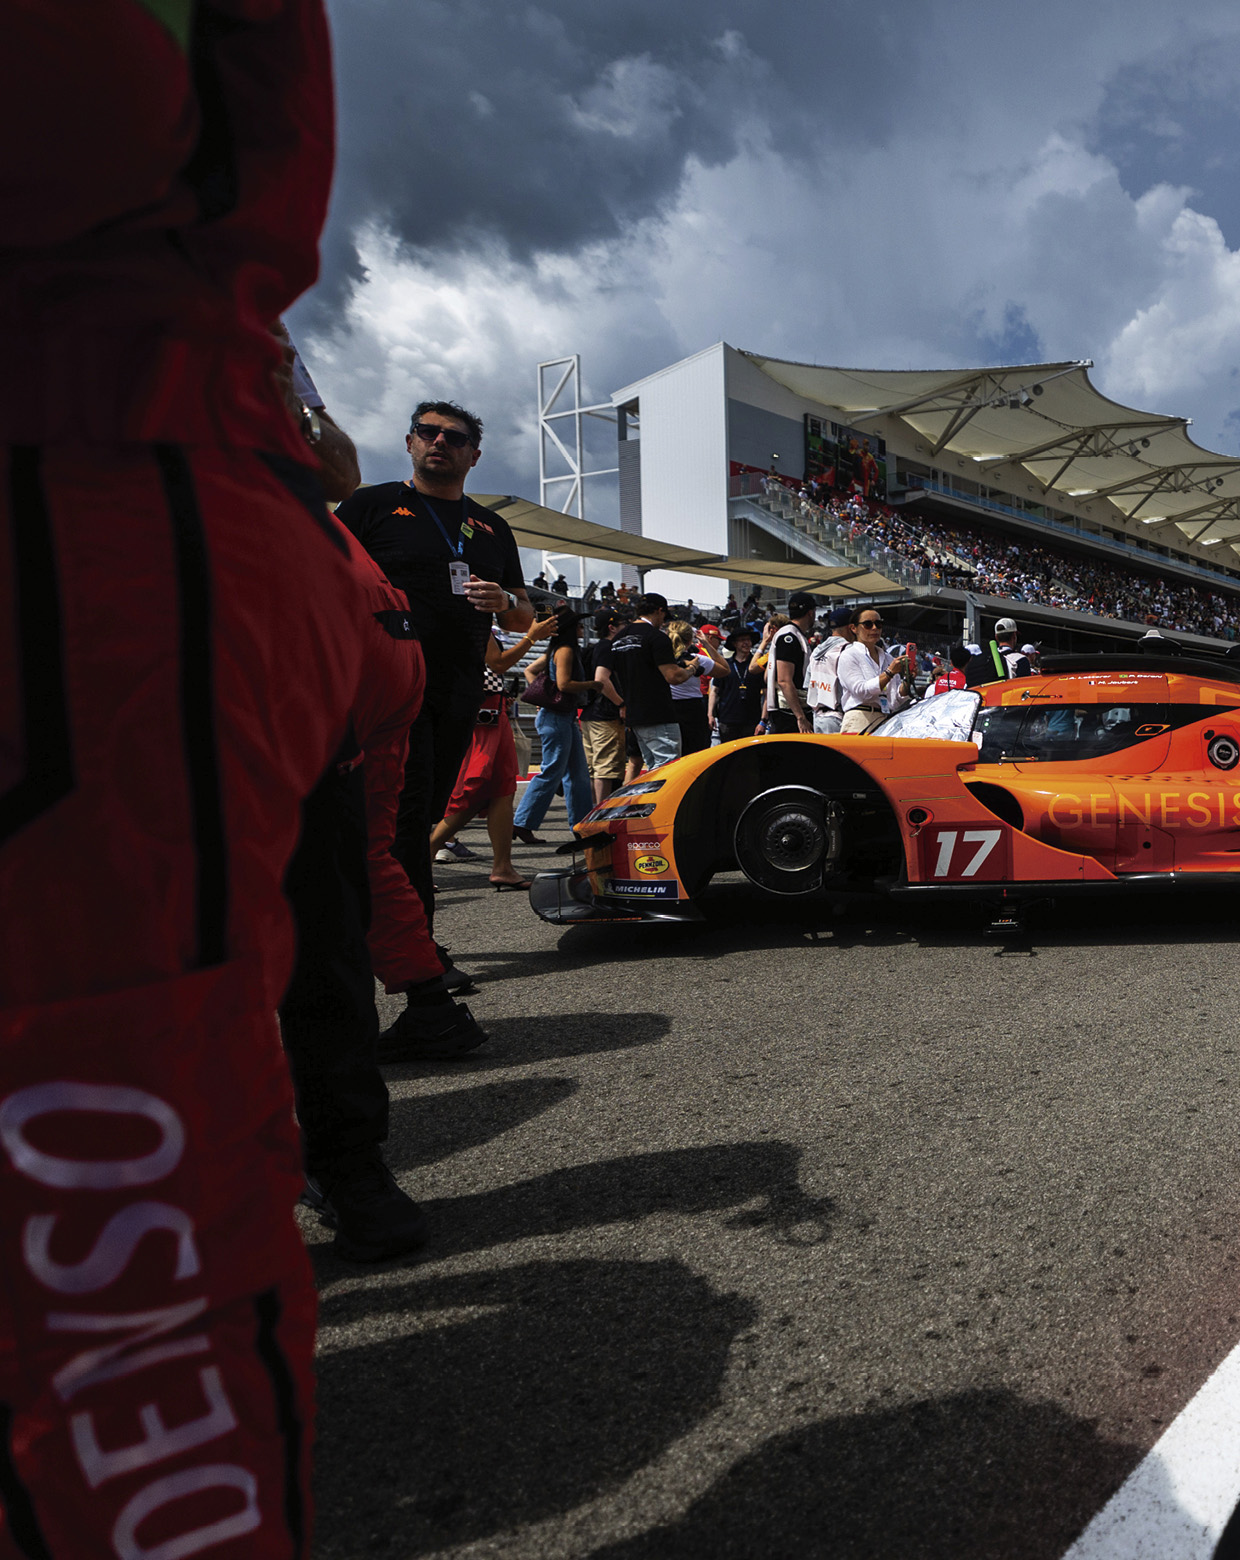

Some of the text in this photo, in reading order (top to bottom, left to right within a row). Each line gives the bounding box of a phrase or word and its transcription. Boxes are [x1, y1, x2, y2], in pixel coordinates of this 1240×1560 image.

[627, 841, 660, 850] sparco
[934, 830, 1001, 877] 17
[638, 860, 664, 869] PENNZOIL
[0, 1081, 262, 1560] DENSO
